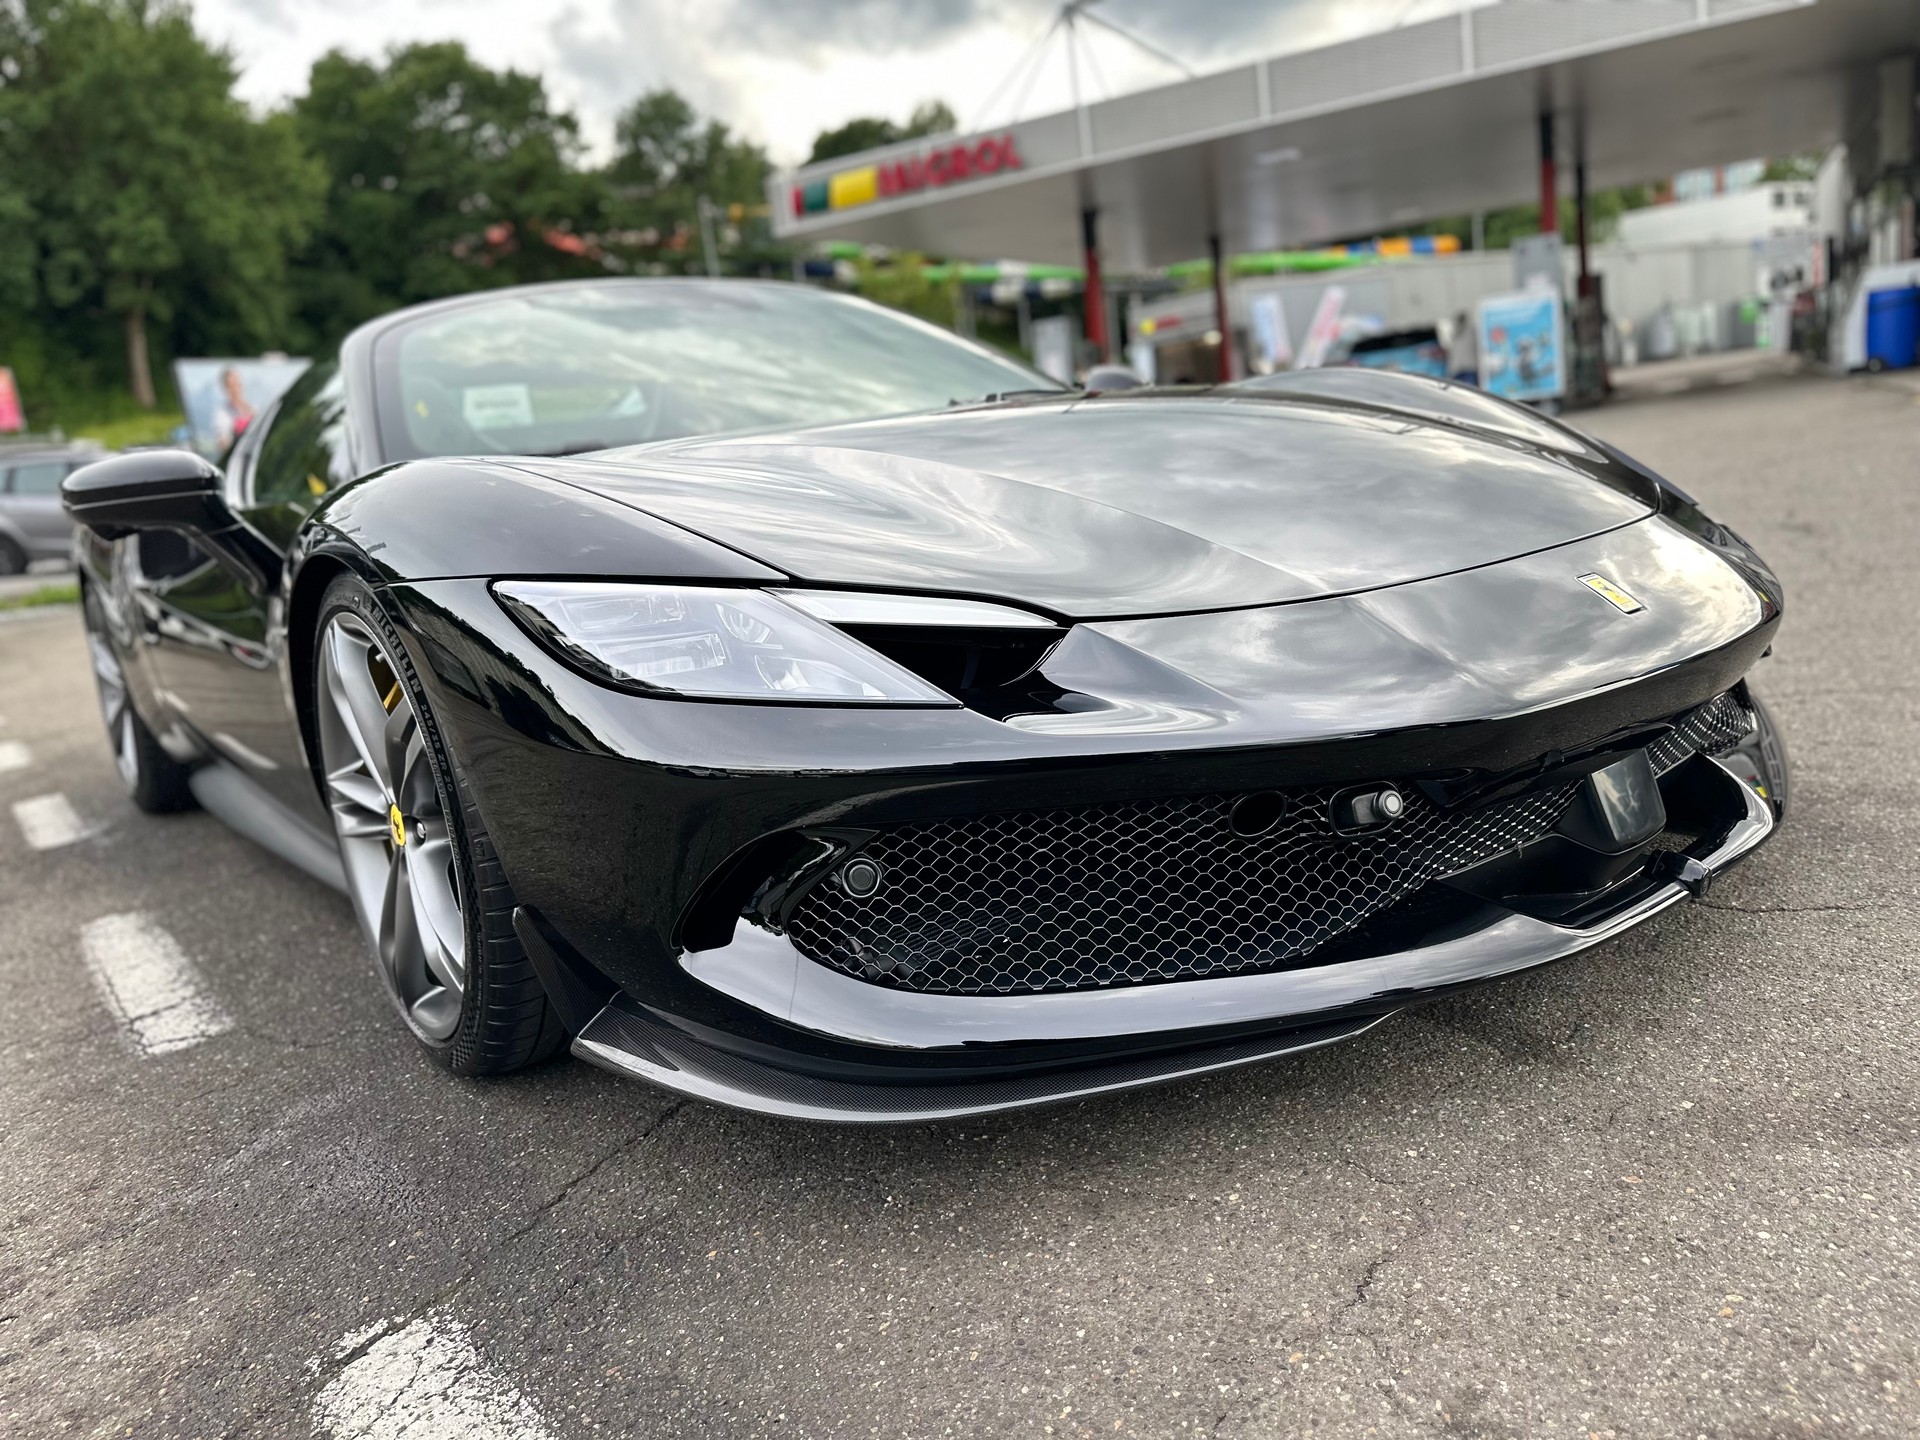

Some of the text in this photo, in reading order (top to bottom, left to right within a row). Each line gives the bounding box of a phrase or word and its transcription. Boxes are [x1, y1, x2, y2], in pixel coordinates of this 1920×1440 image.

[879, 134, 1021, 197] MIGROL
[372, 606, 422, 693] MICHELIN
[438, 753, 448, 770] ZR
[444, 775, 453, 792] 20
